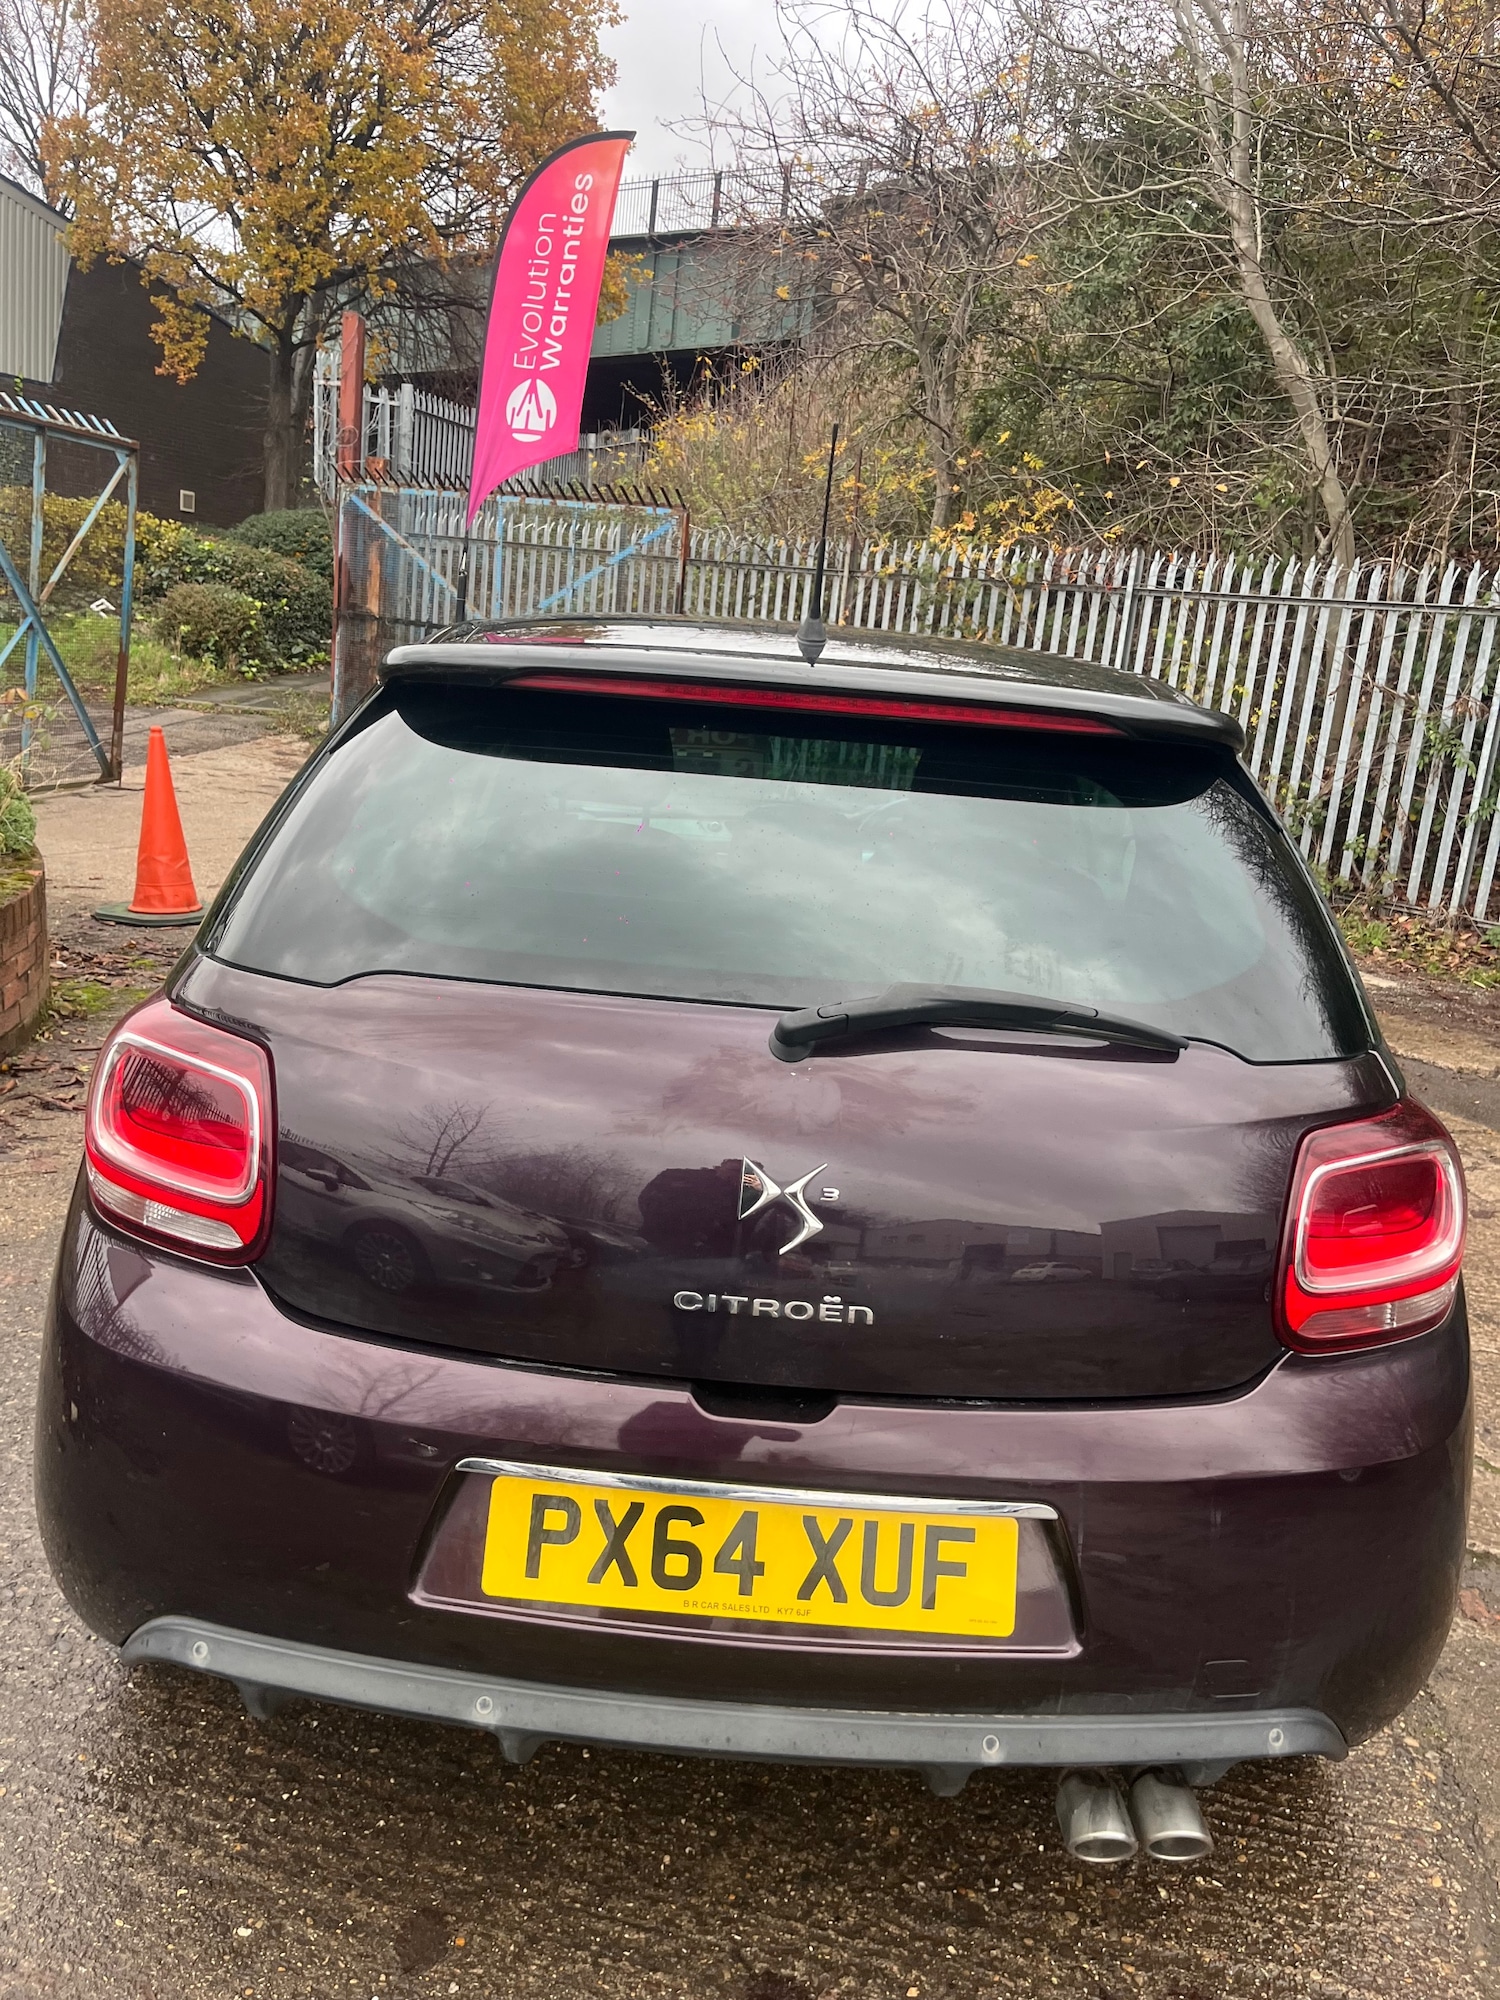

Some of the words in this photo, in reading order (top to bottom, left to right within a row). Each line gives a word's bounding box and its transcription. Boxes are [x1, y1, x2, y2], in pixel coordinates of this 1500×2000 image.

[513, 212, 557, 370] Evolution
[539, 173, 594, 371] Warranties
[819, 1187, 840, 1202] 3
[525, 1493, 766, 1597] PX64
[796, 1514, 976, 1611] XUF
[683, 1599, 690, 1608] B
[692, 1600, 699, 1608] R
[700, 1601, 719, 1610] CAR
[721, 1602, 751, 1613] SALES
[752, 1604, 770, 1614] LTD
[777, 1607, 794, 1615] KY7
[796, 1608, 812, 1617] 6JF
